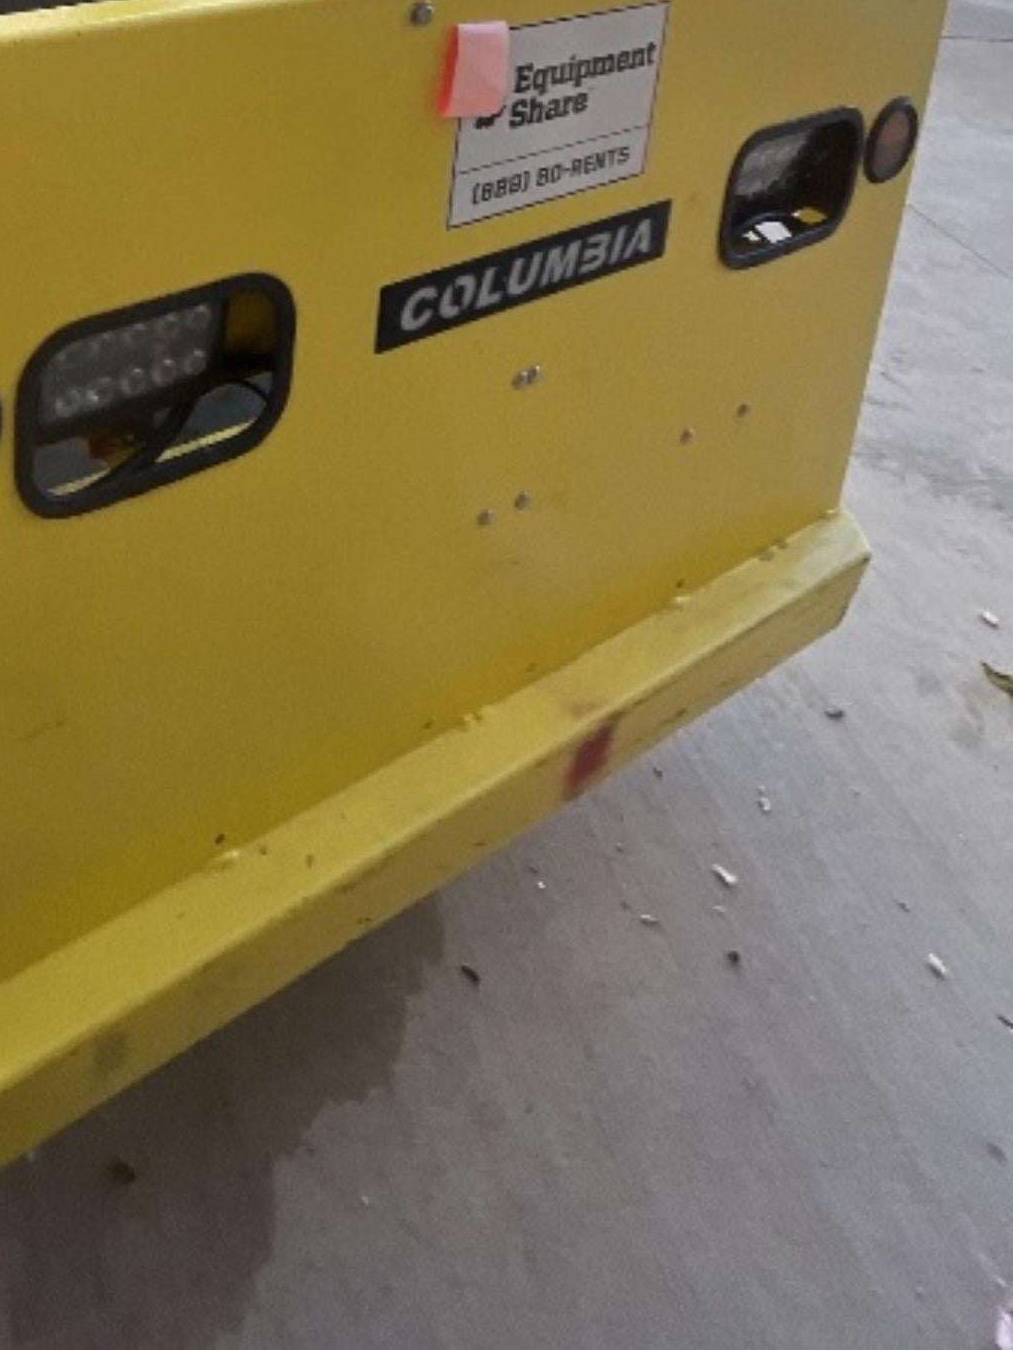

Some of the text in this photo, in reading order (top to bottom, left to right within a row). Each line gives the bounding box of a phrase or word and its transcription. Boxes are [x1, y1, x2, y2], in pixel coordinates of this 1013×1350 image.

[513, 41, 657, 96] Equipment
[508, 91, 589, 129] Share
[399, 218, 654, 332] COLUMBIA
